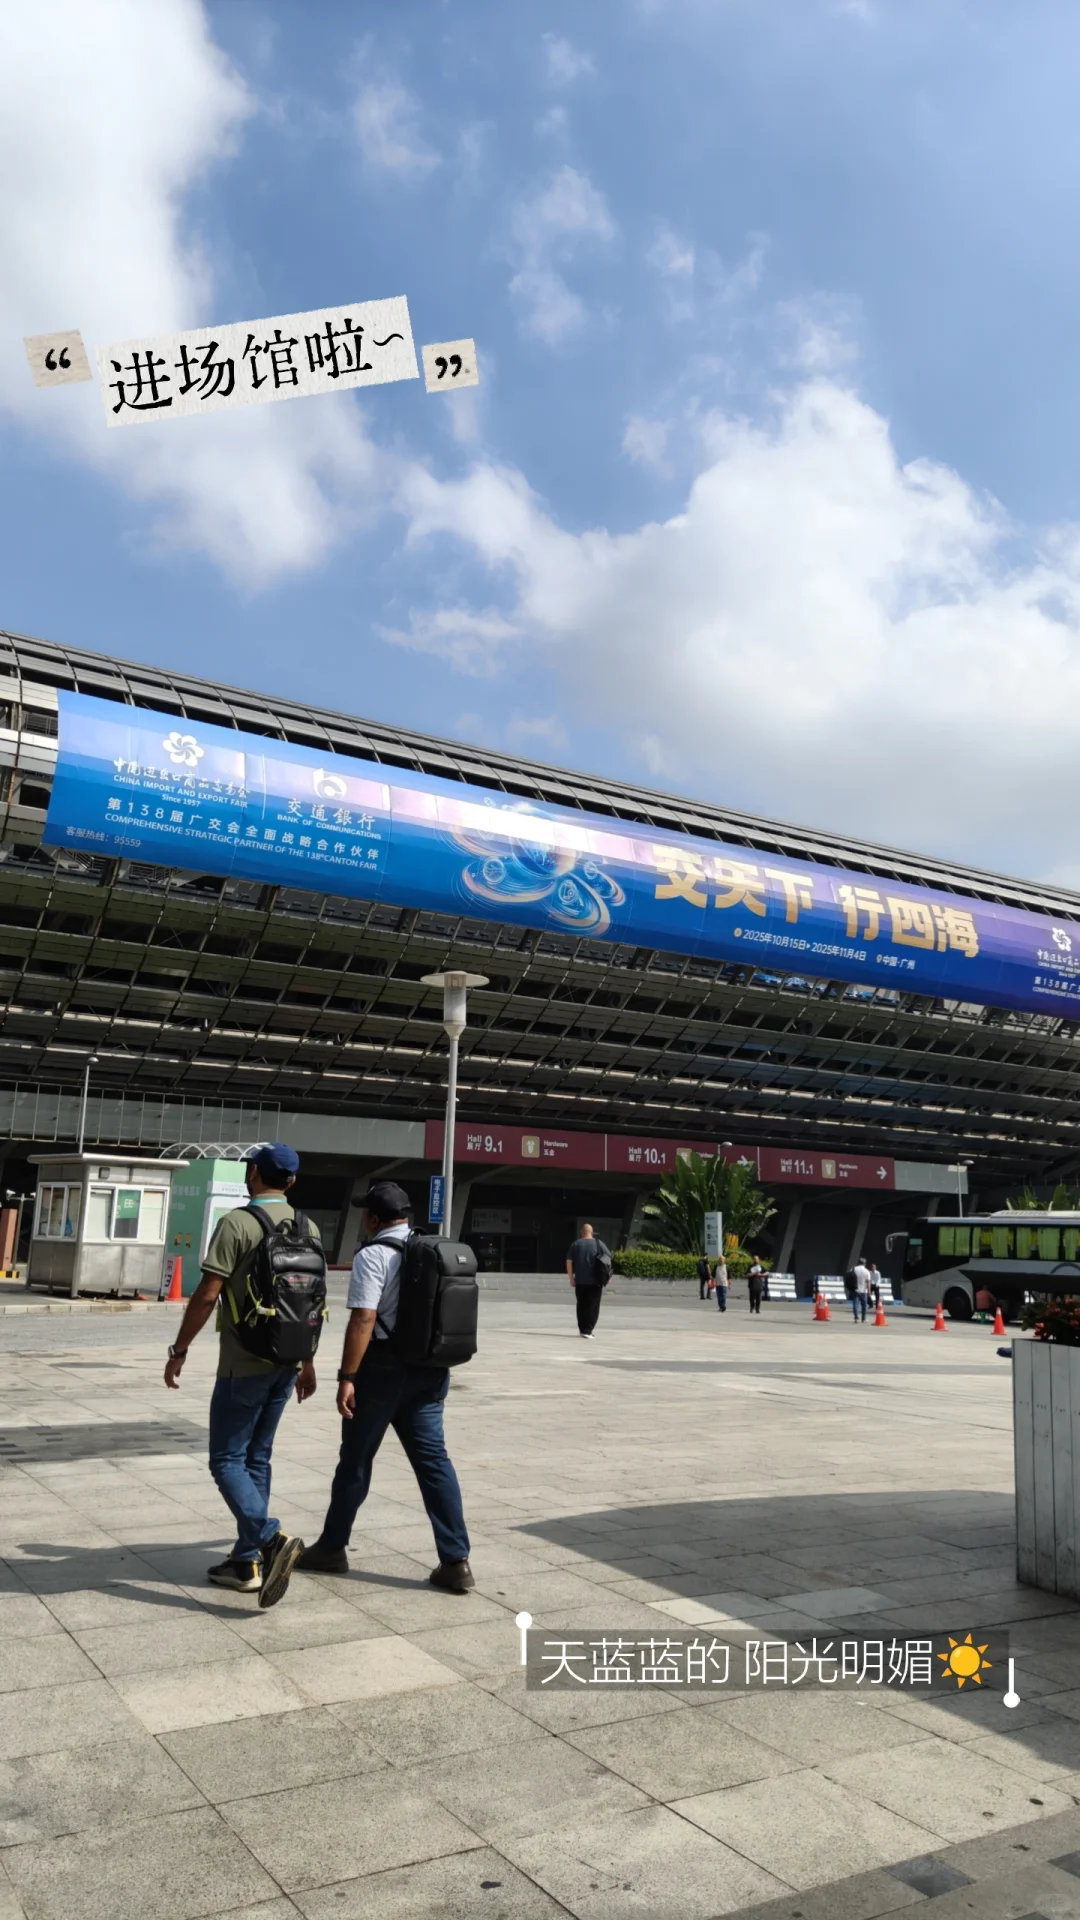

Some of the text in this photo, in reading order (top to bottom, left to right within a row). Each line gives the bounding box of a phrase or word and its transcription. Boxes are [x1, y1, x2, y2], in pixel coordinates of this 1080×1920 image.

[113, 774, 248, 808] CHINA IMPORT AND EXPORT FAIR
[162, 794, 201, 807] Since 1957
[277, 814, 382, 840] BANK OF COMMUNICATIONS
[104, 813, 183, 835] COMPREHENSIVE
[184, 828, 233, 844] STRATEGIC
[233, 837, 274, 851] PARTNER
[275, 845, 287, 853] OF
[288, 847, 304, 857] THE
[359, 861, 378, 871] FAIR
[839, 884, 980, 958] 行四海
[467, 1134, 568, 1153] Hall 9.1 Hardware
[628, 1146, 666, 1164] Hall 10.1
[794, 1160, 814, 1175] 11.1
